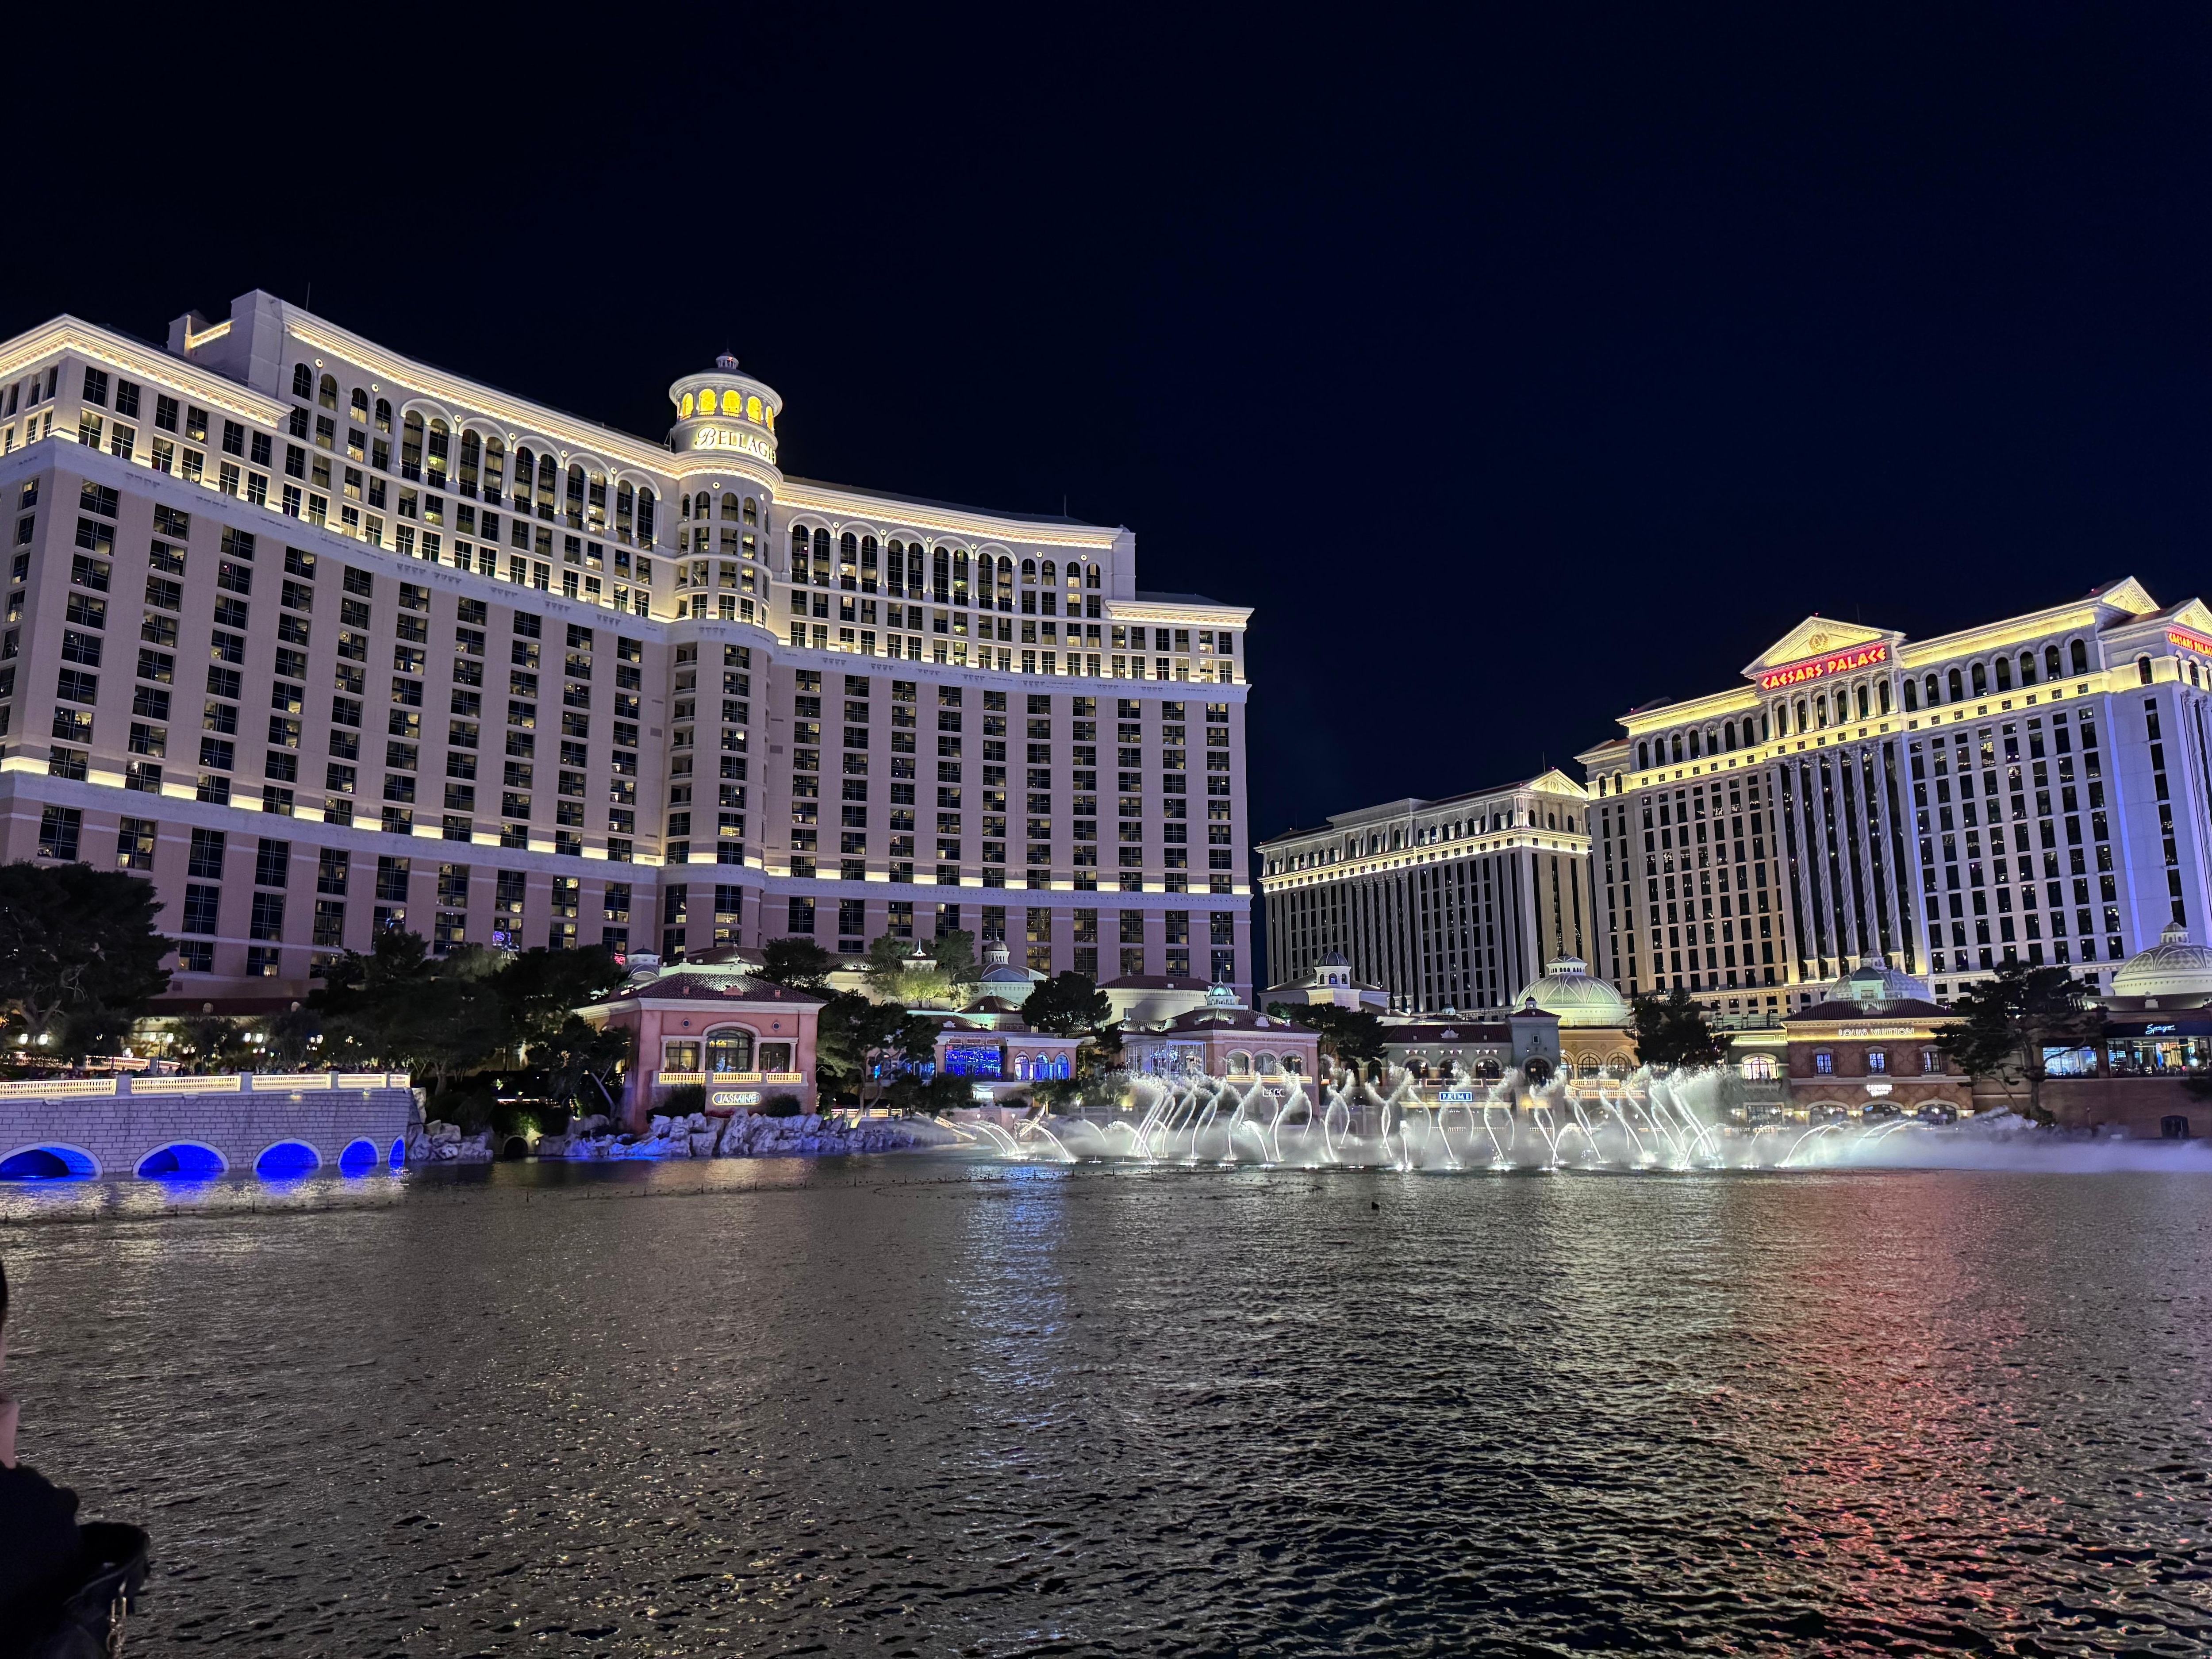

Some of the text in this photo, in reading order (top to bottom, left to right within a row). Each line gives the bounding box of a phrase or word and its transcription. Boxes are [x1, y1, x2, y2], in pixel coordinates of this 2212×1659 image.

[2168, 632, 2212, 657] CAESARS PALAC
[1761, 647, 1886, 690] CAESARS PALACE
[1870, 1027, 1915, 1036] VUITTON
[718, 1094, 757, 1104] JASMINE
